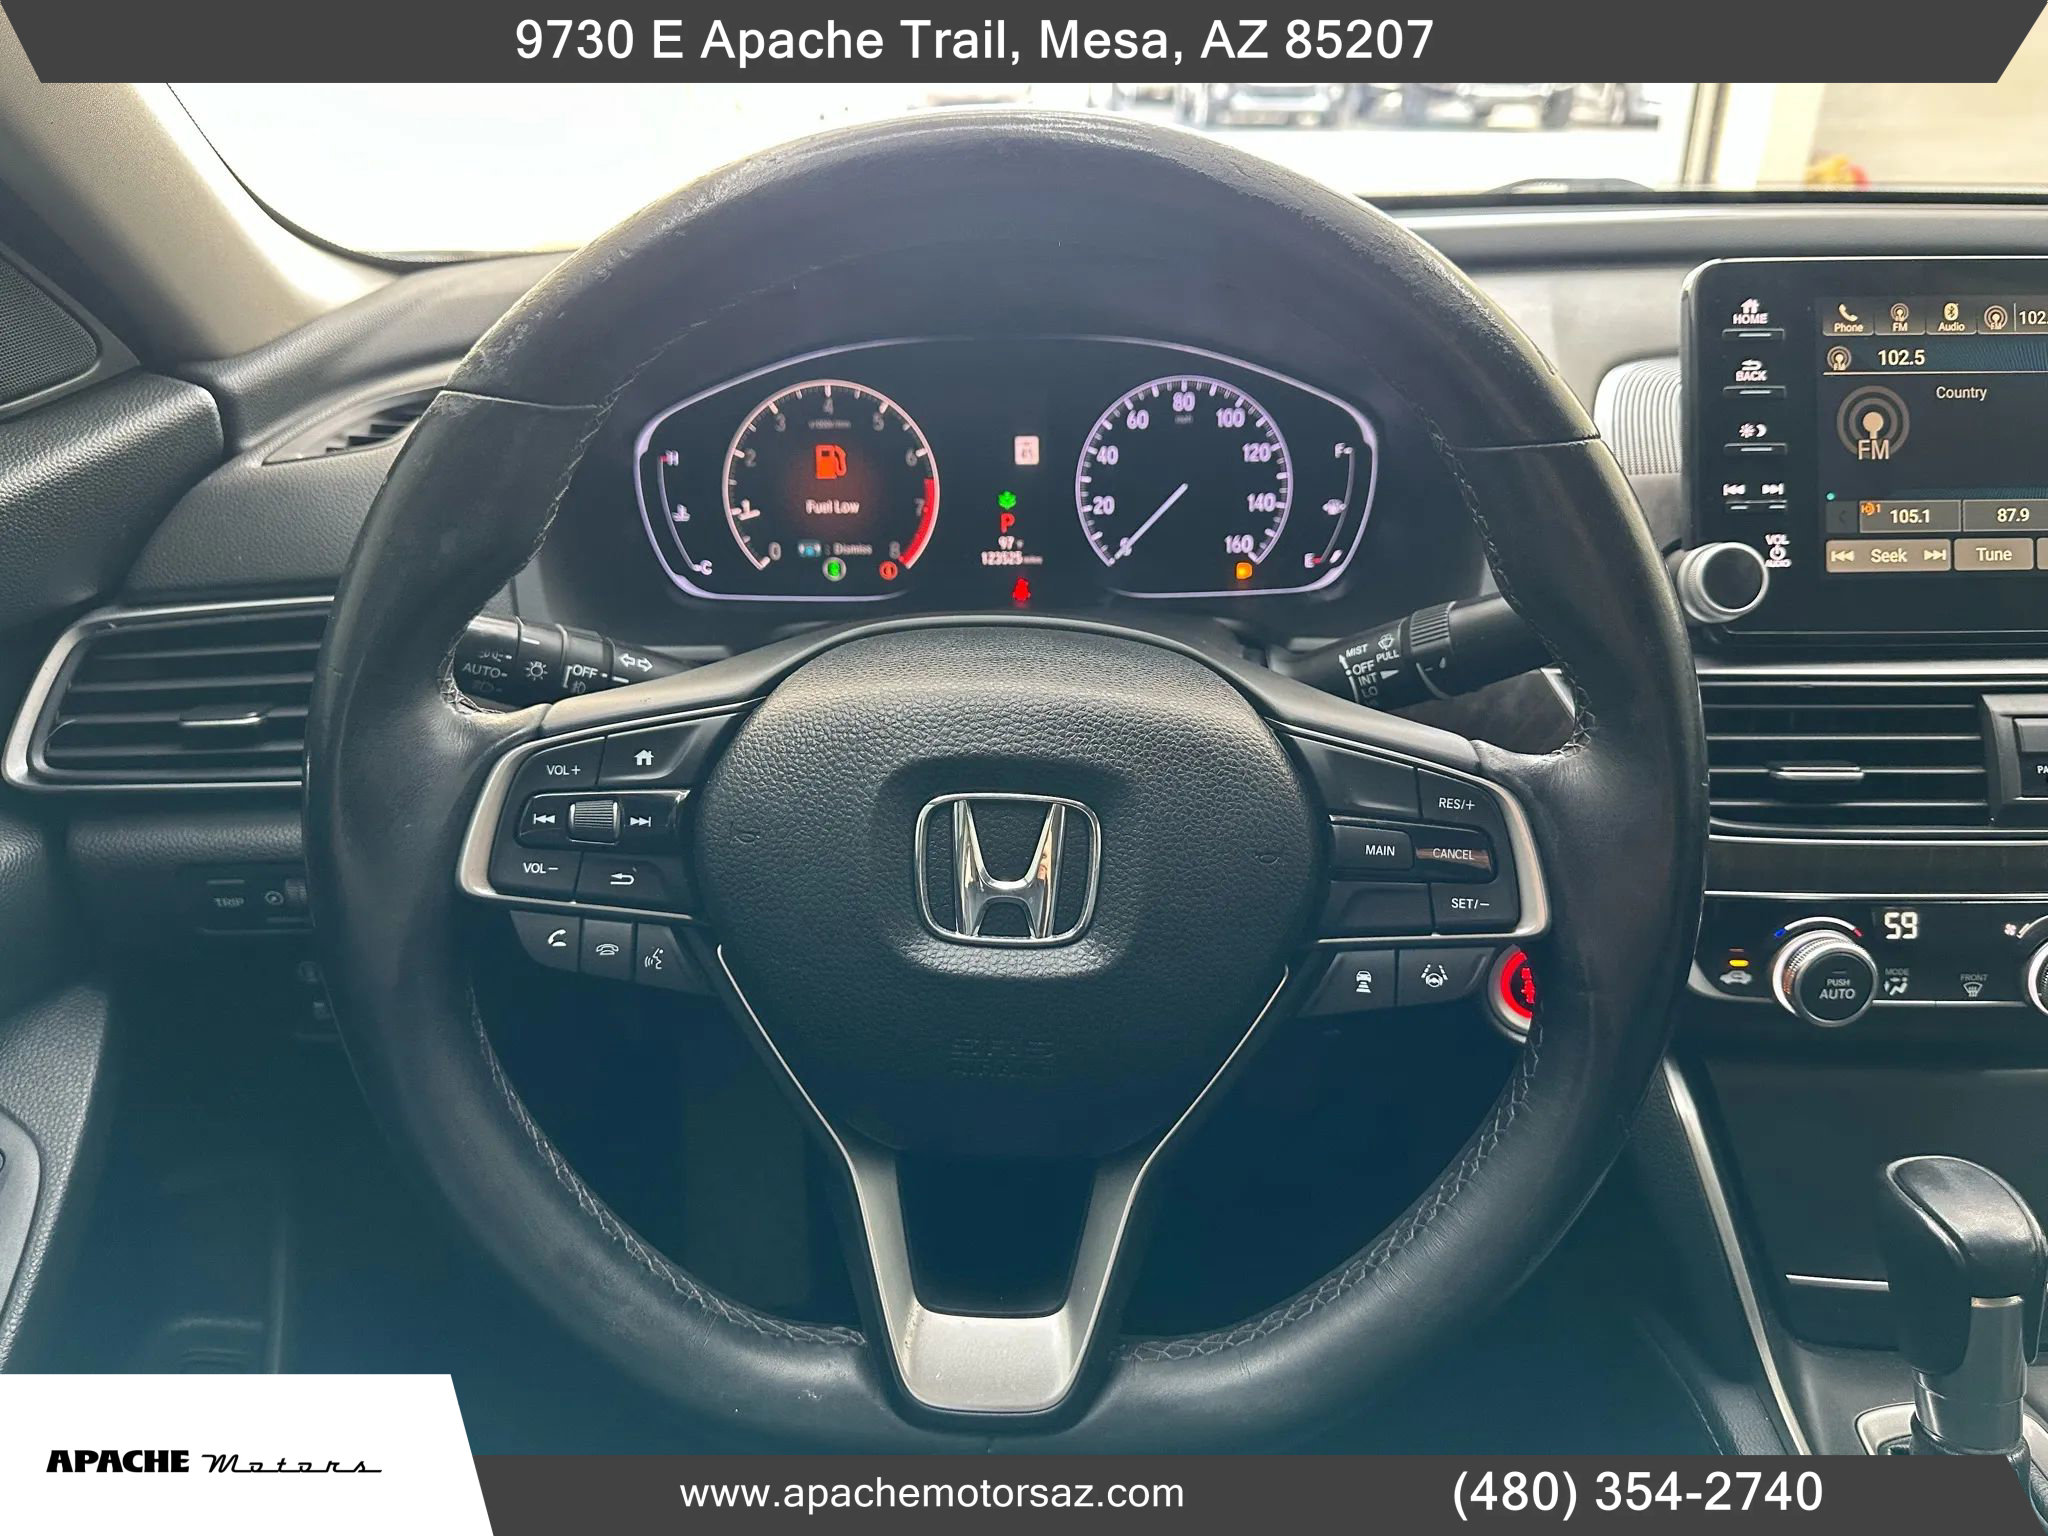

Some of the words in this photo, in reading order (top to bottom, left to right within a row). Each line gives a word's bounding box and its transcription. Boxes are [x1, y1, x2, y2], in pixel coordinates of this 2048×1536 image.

[1733, 313, 1767, 324] HOME
[1834, 321, 1863, 333] Phone
[1892, 322, 1908, 332] FM
[1938, 321, 1965, 332] Audio
[1878, 350, 1925, 365] 102.5
[1736, 370, 1767, 381] BACK
[1936, 386, 1987, 400] Country
[1172, 392, 1196, 411] 80
[1126, 409, 1149, 430] 60
[1216, 408, 1245, 429] 100
[1097, 445, 1119, 465] 40
[1242, 442, 1272, 462] 120
[1334, 443, 1345, 459] F
[1858, 440, 1889, 460] FM
[805, 500, 832, 514] Fuel
[834, 500, 860, 514] Low
[1092, 495, 1115, 515] 20
[1247, 492, 1277, 512] 140
[1000, 513, 1016, 533] P
[1890, 509, 1930, 523] 105.1
[1997, 508, 2030, 523] 87.9
[998, 535, 1015, 550] 97
[1224, 535, 1254, 554] 160
[1765, 533, 1790, 546] VOL
[768, 541, 781, 560] 0
[981, 550, 1023, 566] 123525
[1871, 549, 1908, 564] Seek
[1976, 548, 2013, 562] Tune
[701, 559, 713, 576] C
[1345, 643, 1369, 658] MIST
[1376, 649, 1400, 663] PULL
[463, 663, 500, 678] AUTO
[573, 664, 598, 678] OFF
[1352, 659, 1375, 675] OFF
[1358, 671, 1377, 687] INT
[1361, 685, 1378, 699] LO
[1365, 844, 1395, 857] MAIN
[1432, 847, 1475, 861] CANCEL
[214, 896, 244, 908] TRIP
[1884, 911, 1918, 940] 59
[1884, 967, 1910, 976] MODE
[1960, 973, 1988, 982] FRONT
[1826, 977, 1850, 988] PUSH
[1819, 988, 1856, 1000] AUTO
